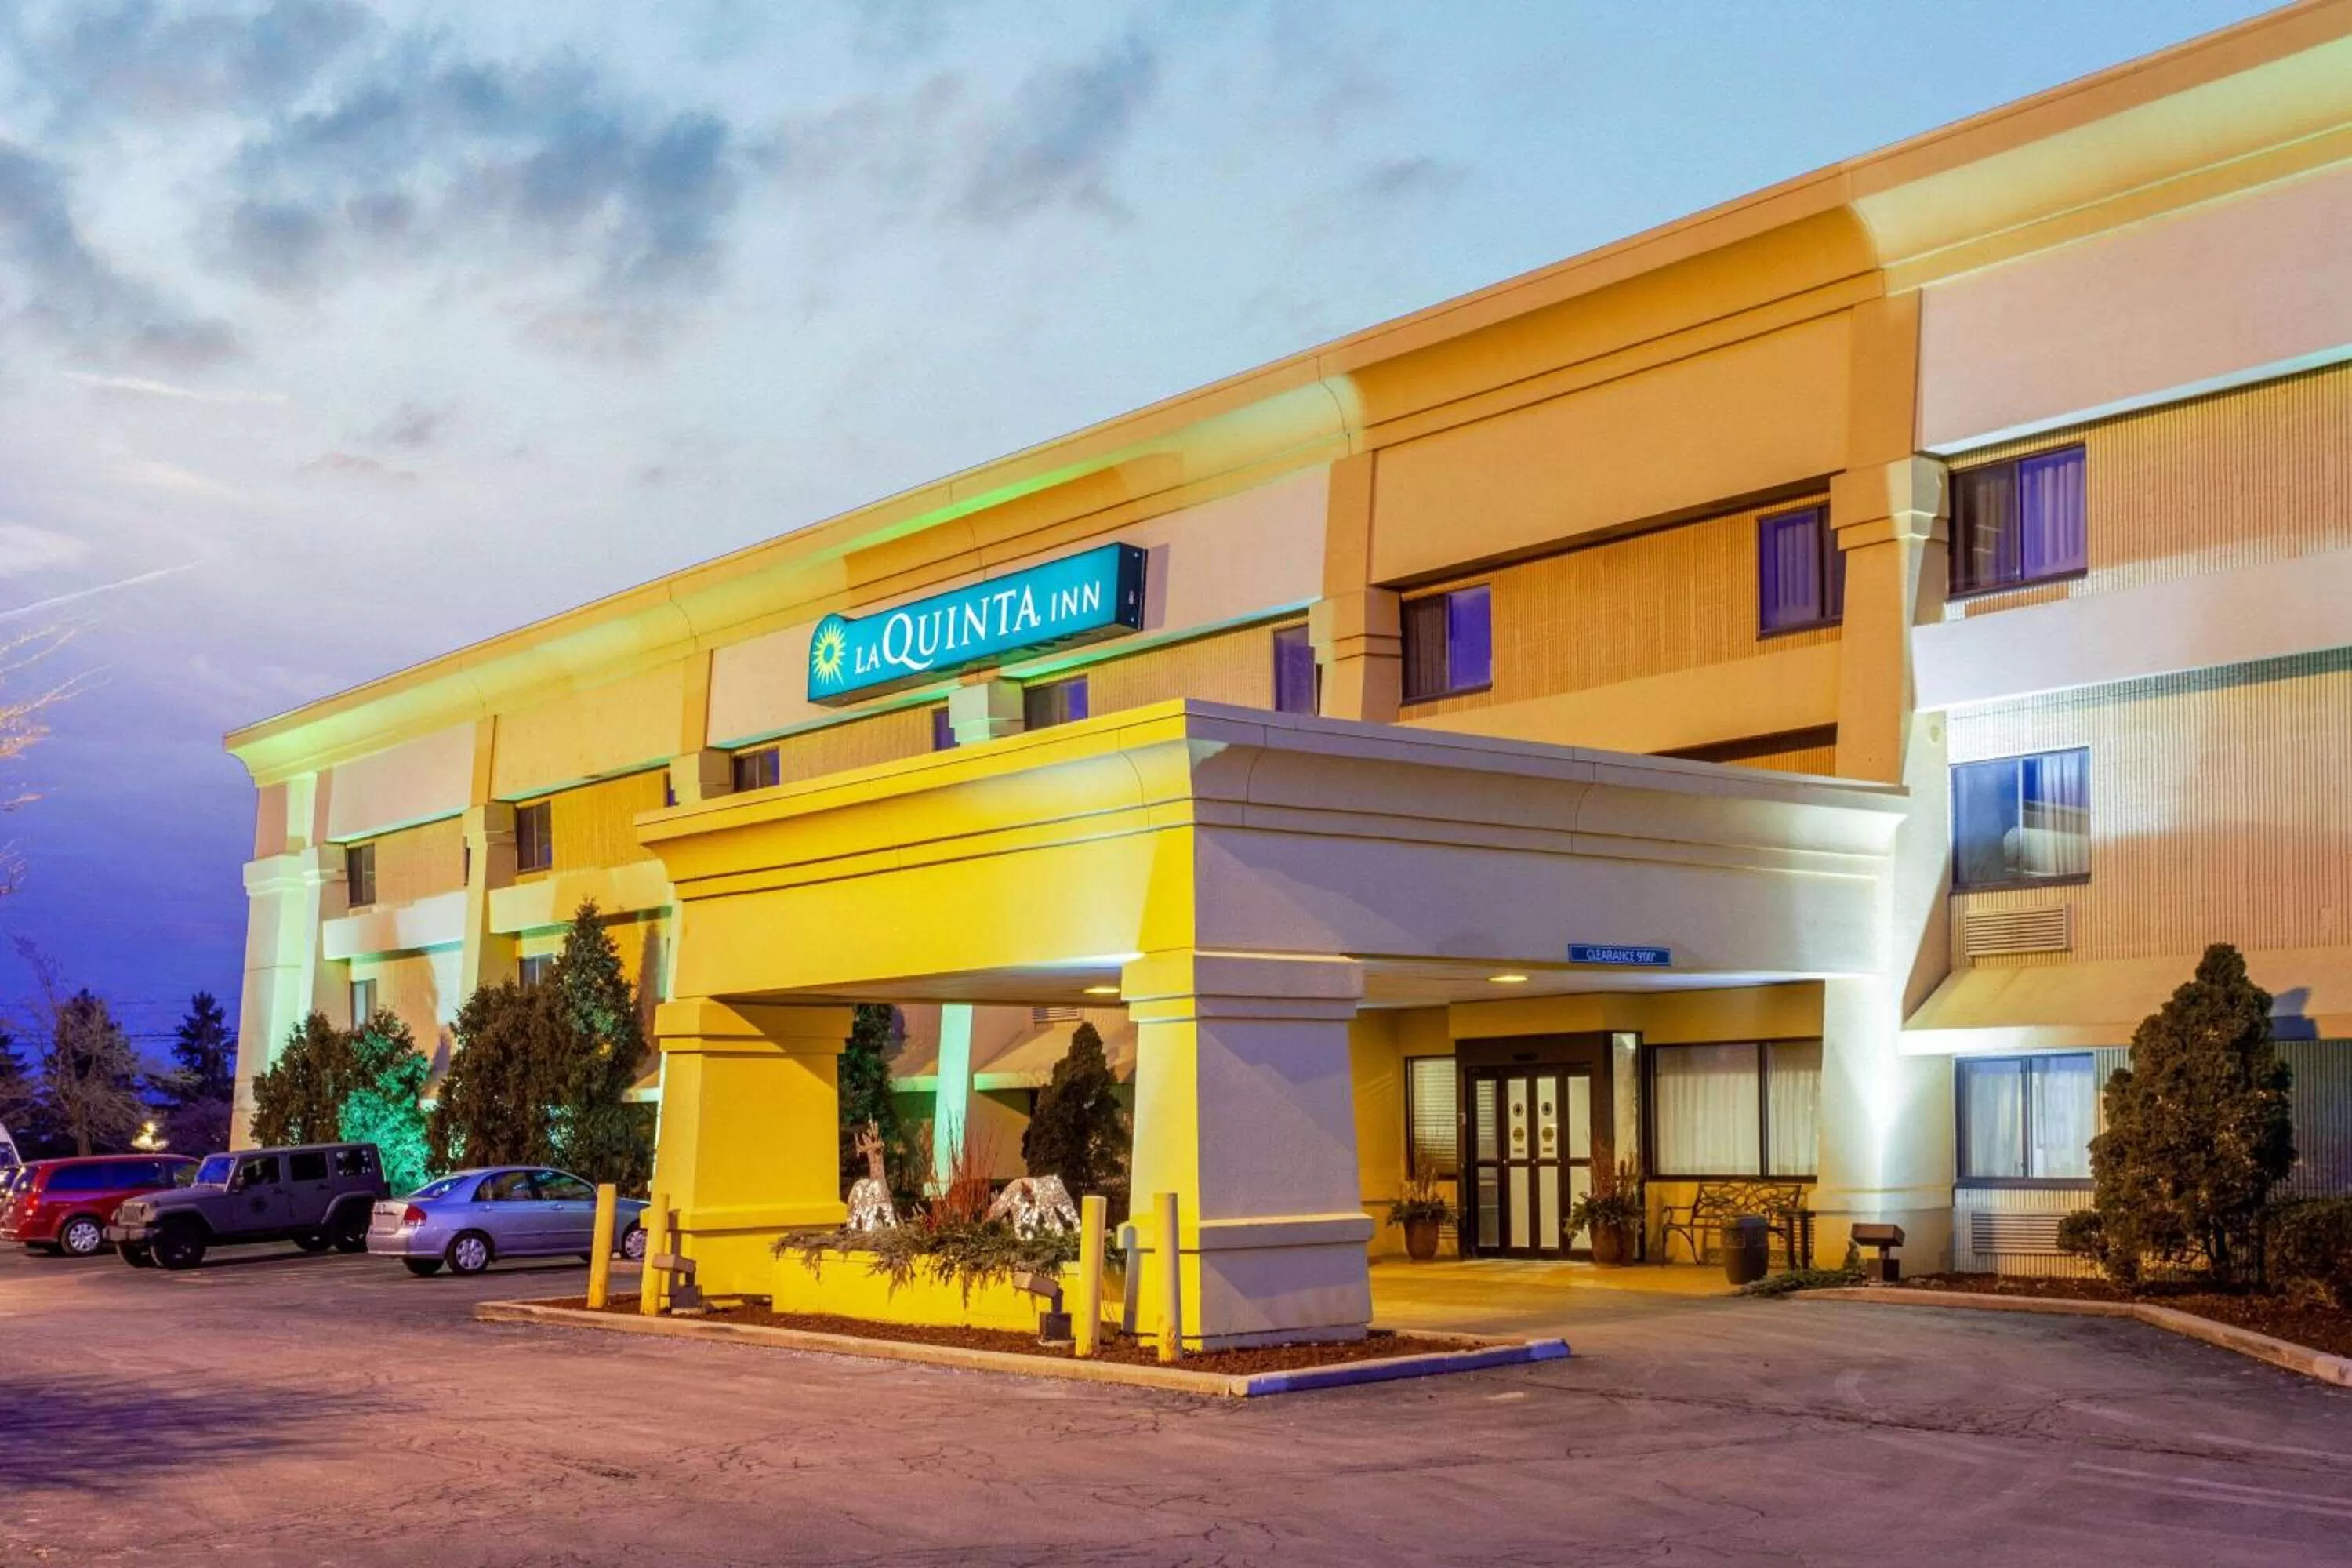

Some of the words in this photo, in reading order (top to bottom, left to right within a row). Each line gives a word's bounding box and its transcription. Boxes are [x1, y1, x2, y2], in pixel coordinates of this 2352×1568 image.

[855, 642, 881, 674] LA
[882, 583, 1041, 670] QUINTA
[1051, 579, 1100, 622] INN
[1586, 949, 1635, 962] CLEARANCE
